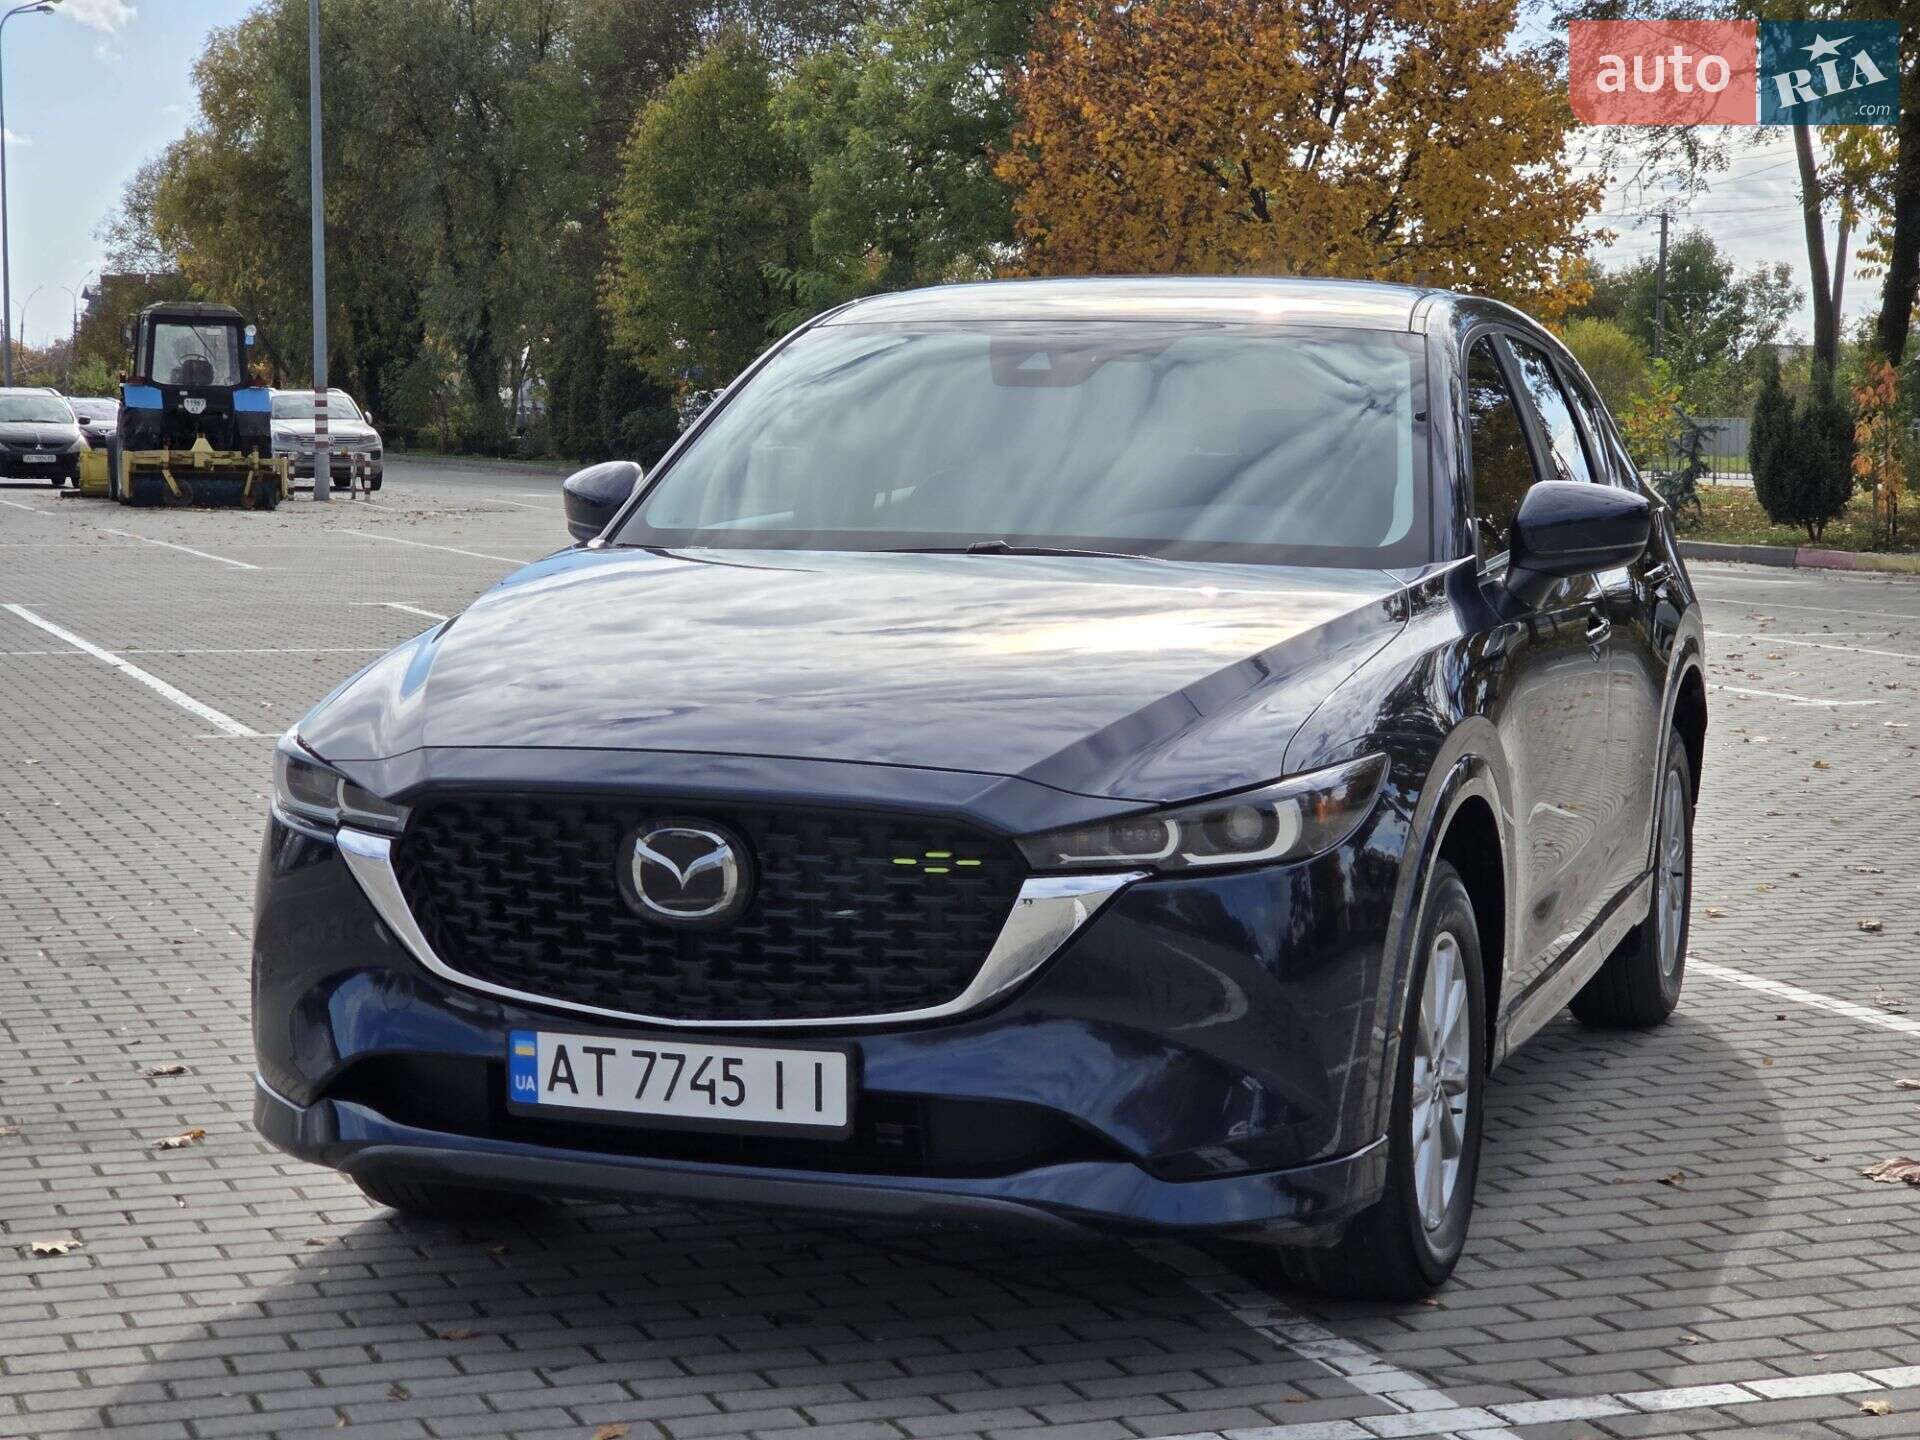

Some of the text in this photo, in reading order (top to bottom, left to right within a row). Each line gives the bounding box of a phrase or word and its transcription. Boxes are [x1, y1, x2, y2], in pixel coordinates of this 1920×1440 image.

[515, 1075, 535, 1091] UA
[547, 1044, 616, 1097] AT
[631, 1050, 746, 1107] 7745
